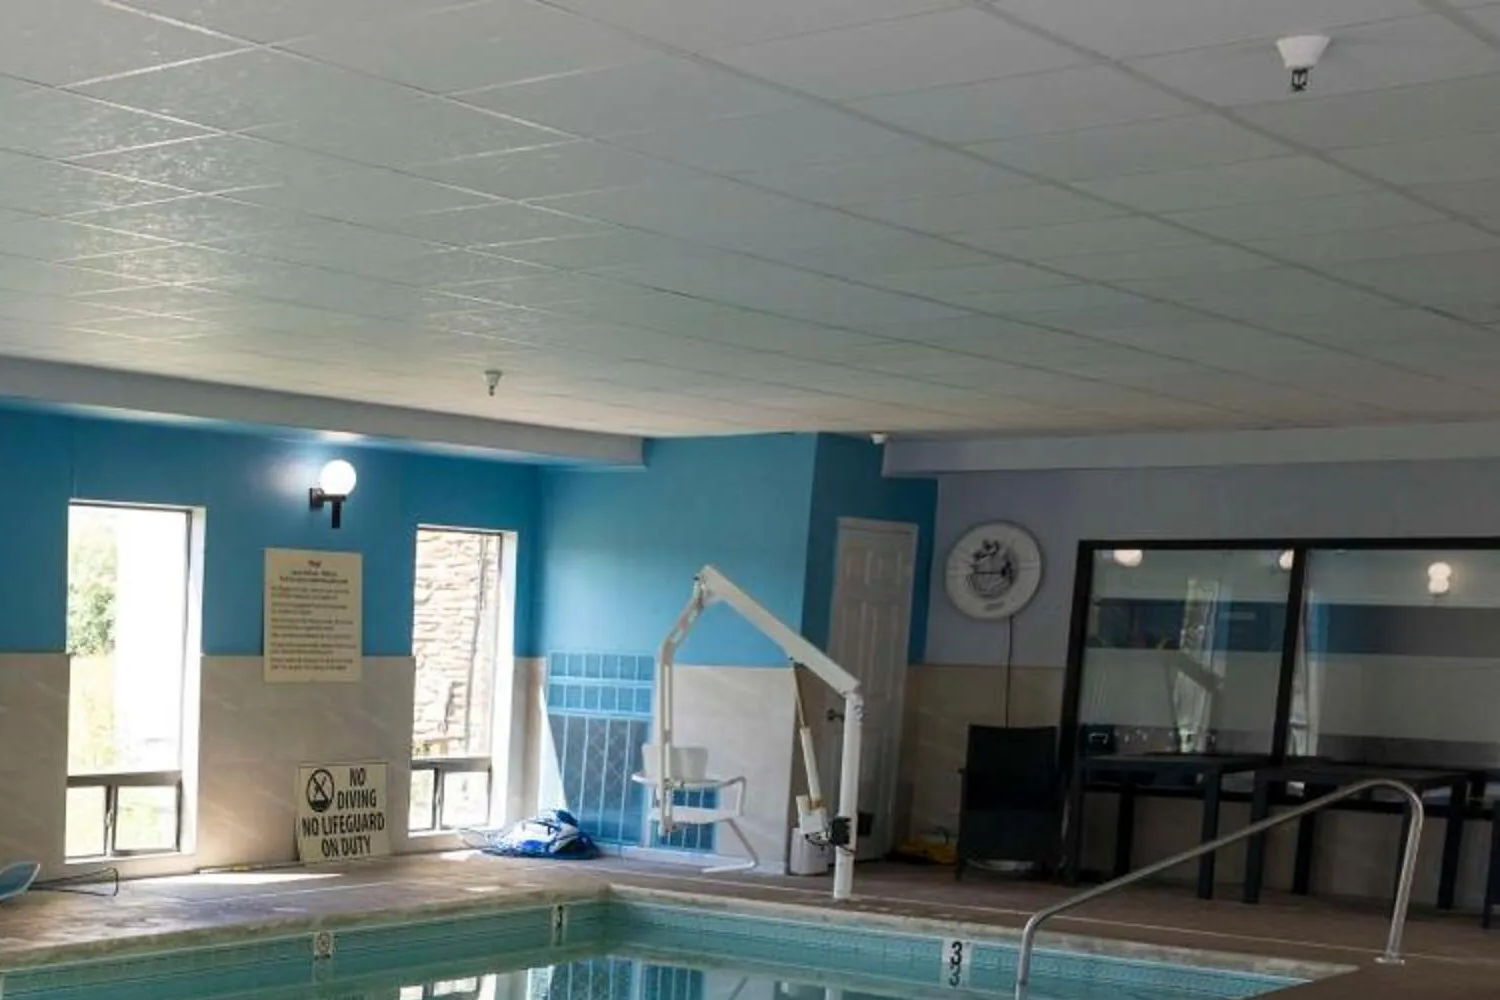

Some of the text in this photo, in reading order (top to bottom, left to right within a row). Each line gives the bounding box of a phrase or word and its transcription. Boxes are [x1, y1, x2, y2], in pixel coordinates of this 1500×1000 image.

[349, 767, 366, 787] NO
[337, 788, 377, 810] DIVING
[302, 811, 385, 837] NO LIFEGUARD
[321, 834, 371, 857] ON DUTY
[950, 941, 962, 965] 3
